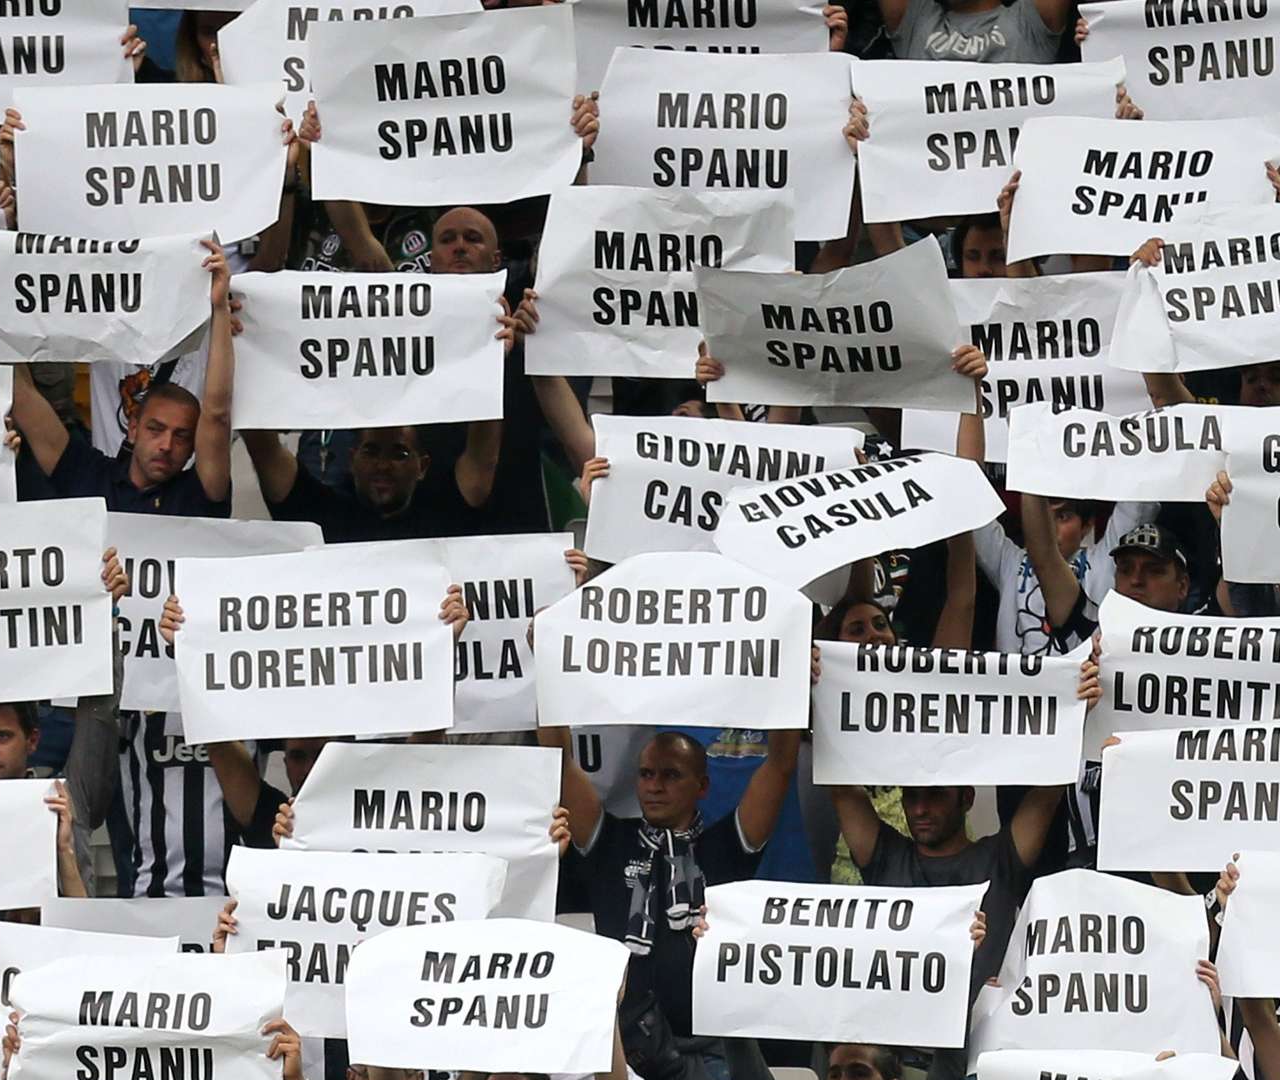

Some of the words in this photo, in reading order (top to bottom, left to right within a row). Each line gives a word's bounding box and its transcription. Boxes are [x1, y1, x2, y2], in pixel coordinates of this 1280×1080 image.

[374, 55, 506, 102] MARIO
[1147, 36, 1274, 87] SPANU
[657, 92, 787, 131] MARIO
[924, 75, 1056, 115] MARIO
[86, 107, 216, 148] MARIO
[377, 112, 513, 161] SPANU
[652, 146, 788, 189] SPANU
[1083, 149, 1214, 181] MARIO
[14, 272, 142, 314] SPANU
[758, 300, 894, 339] MARIO
[299, 335, 435, 380] SPANU
[1063, 415, 1222, 458] CASULA
[774, 475, 934, 549] CASULA
[219, 588, 407, 633] ROBERTO
[580, 585, 767, 625] ROBERTO
[205, 642, 423, 690] LORENTINI
[562, 635, 780, 678] LORENTINI
[840, 691, 1057, 735] LORENTINI
[267, 884, 456, 932] JACQUES
[1024, 913, 1145, 961] MARIO
[421, 950, 555, 984] MARIO
[716, 942, 946, 994] PISTOLATO
[78, 991, 212, 1031] MARIO
